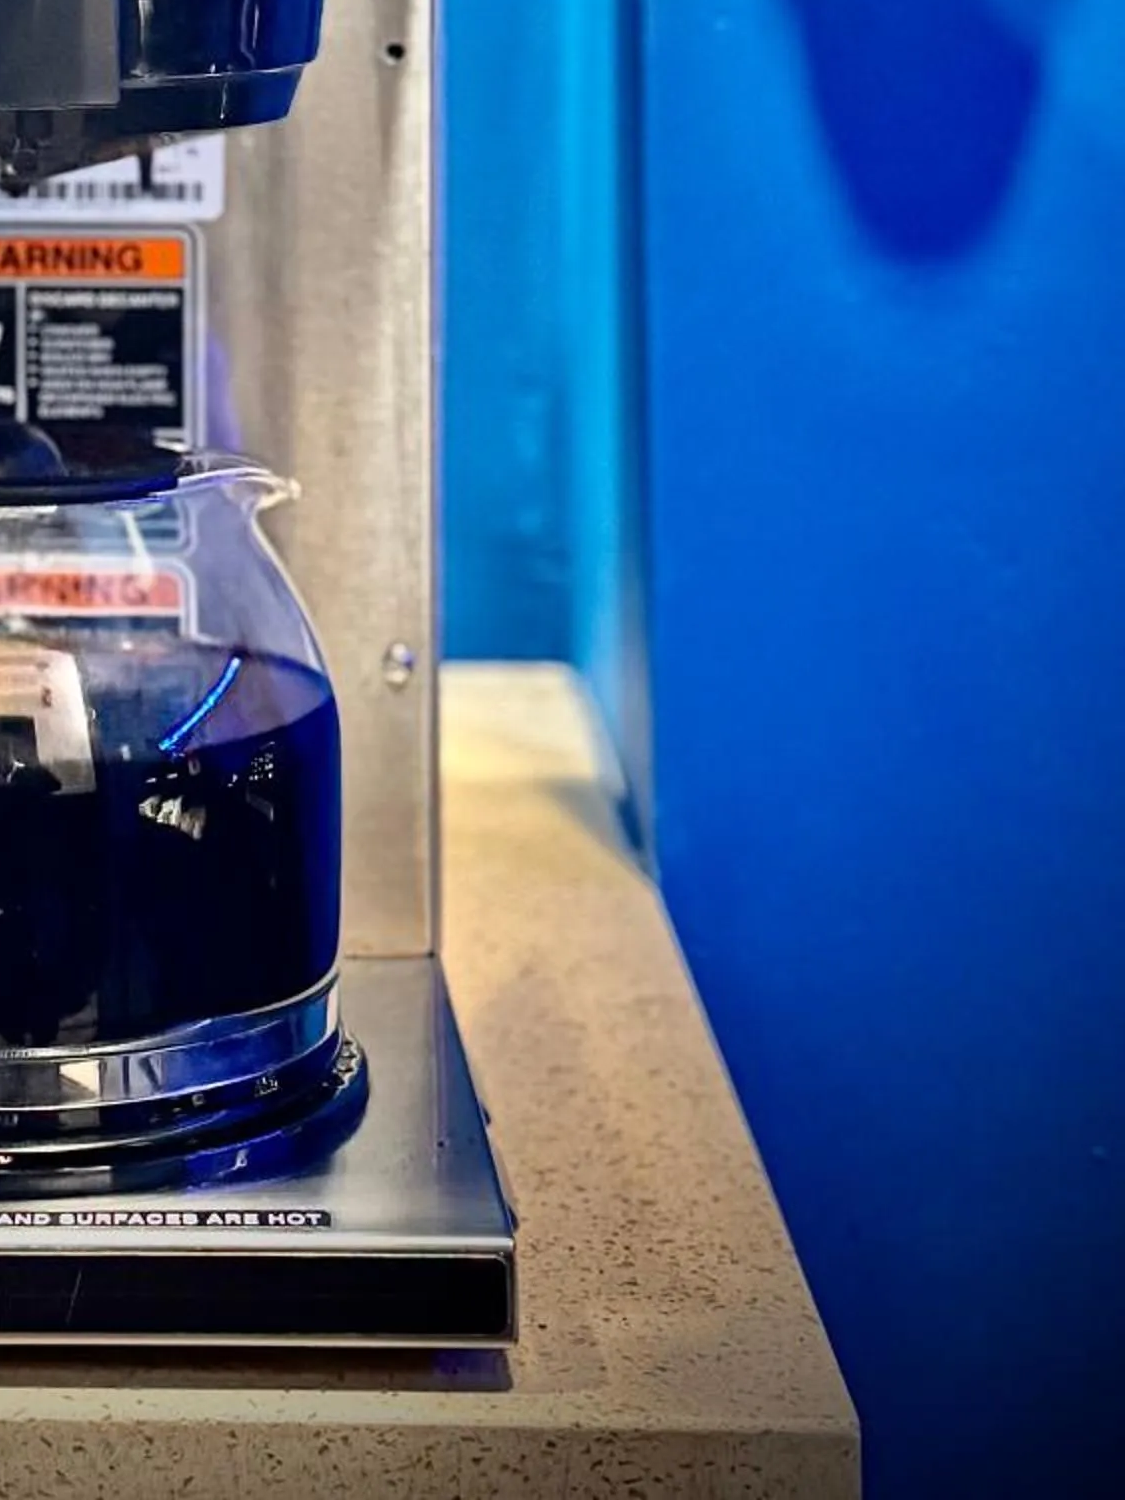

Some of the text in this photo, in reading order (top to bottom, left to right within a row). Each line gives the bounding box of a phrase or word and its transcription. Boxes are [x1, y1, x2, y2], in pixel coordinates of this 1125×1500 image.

[59, 1213, 199, 1225] SURFACES
[206, 1213, 259, 1225] ARE
[268, 1213, 321, 1225] HOT
